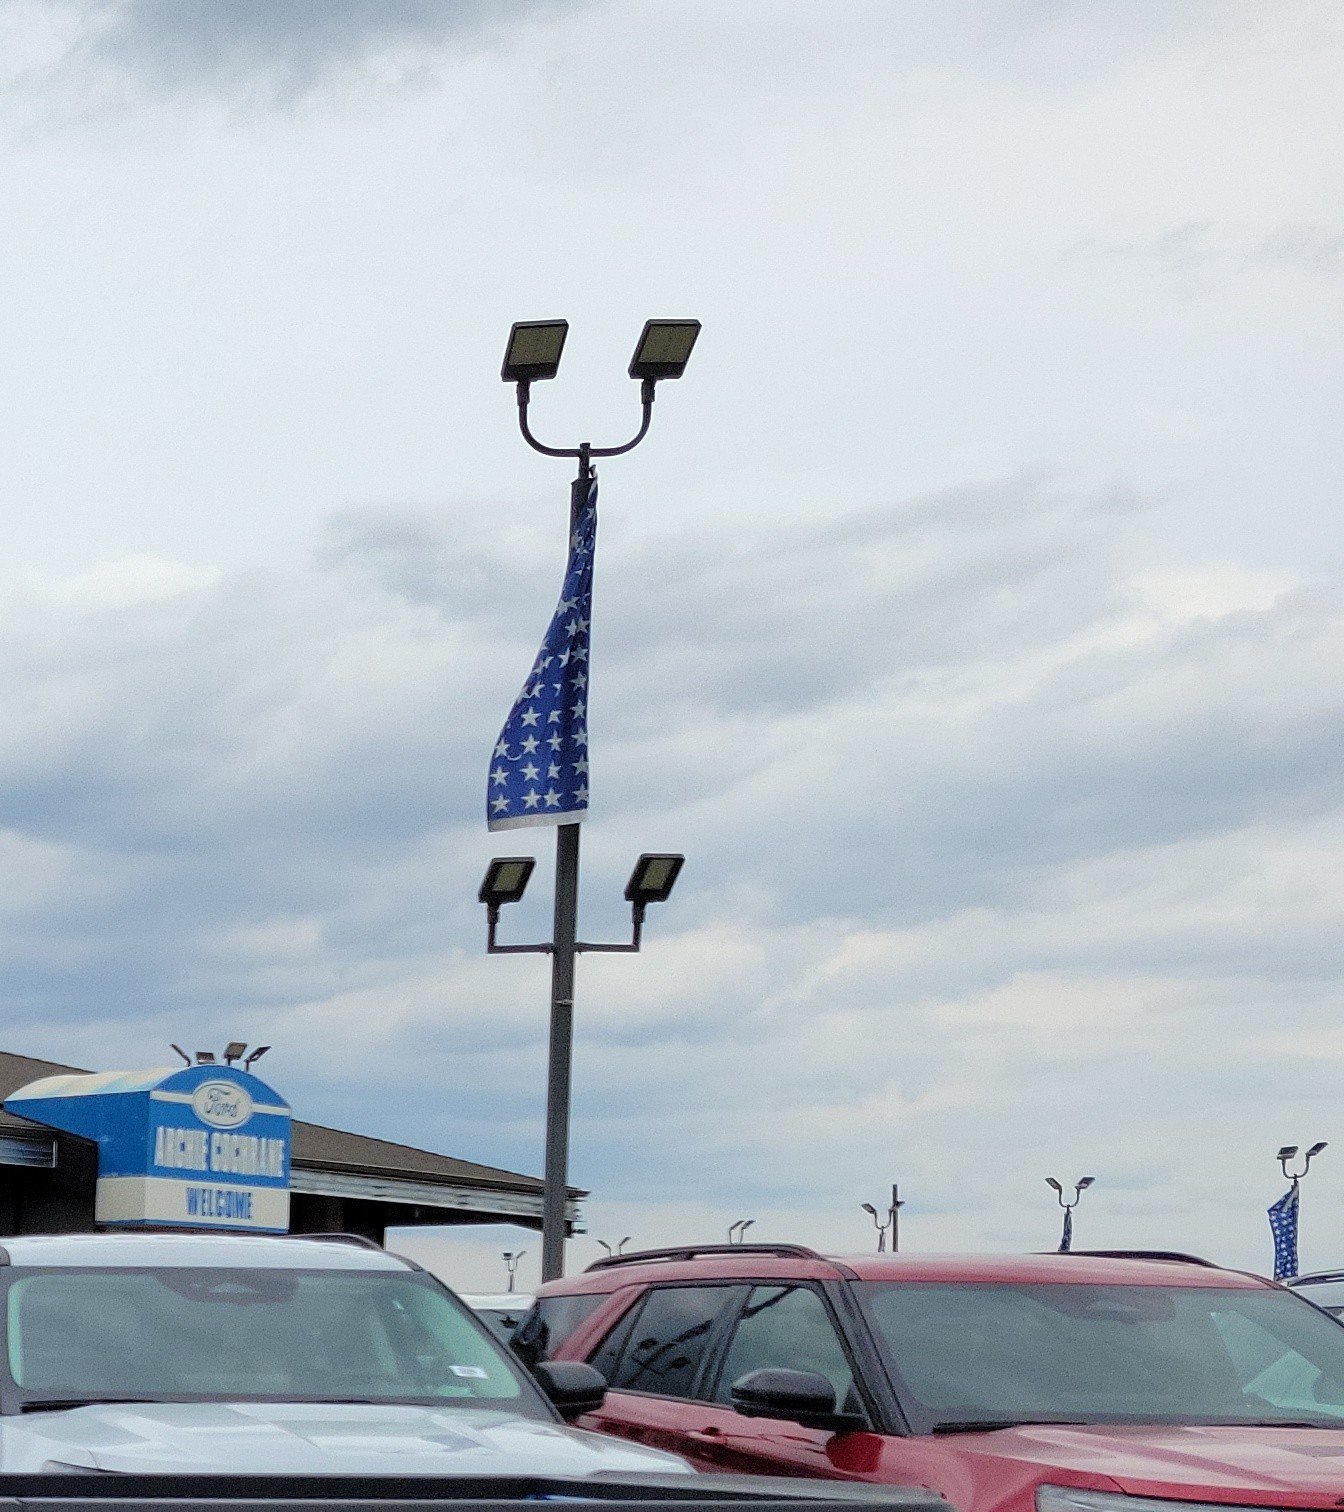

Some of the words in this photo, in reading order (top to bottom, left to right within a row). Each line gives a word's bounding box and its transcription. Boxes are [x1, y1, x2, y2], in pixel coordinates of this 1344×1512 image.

[205, 1087, 241, 1118] Ford
[154, 1126, 208, 1171] ARCHIE
[211, 1132, 285, 1178] COCHRANE
[186, 1187, 253, 1219] WELCOME
